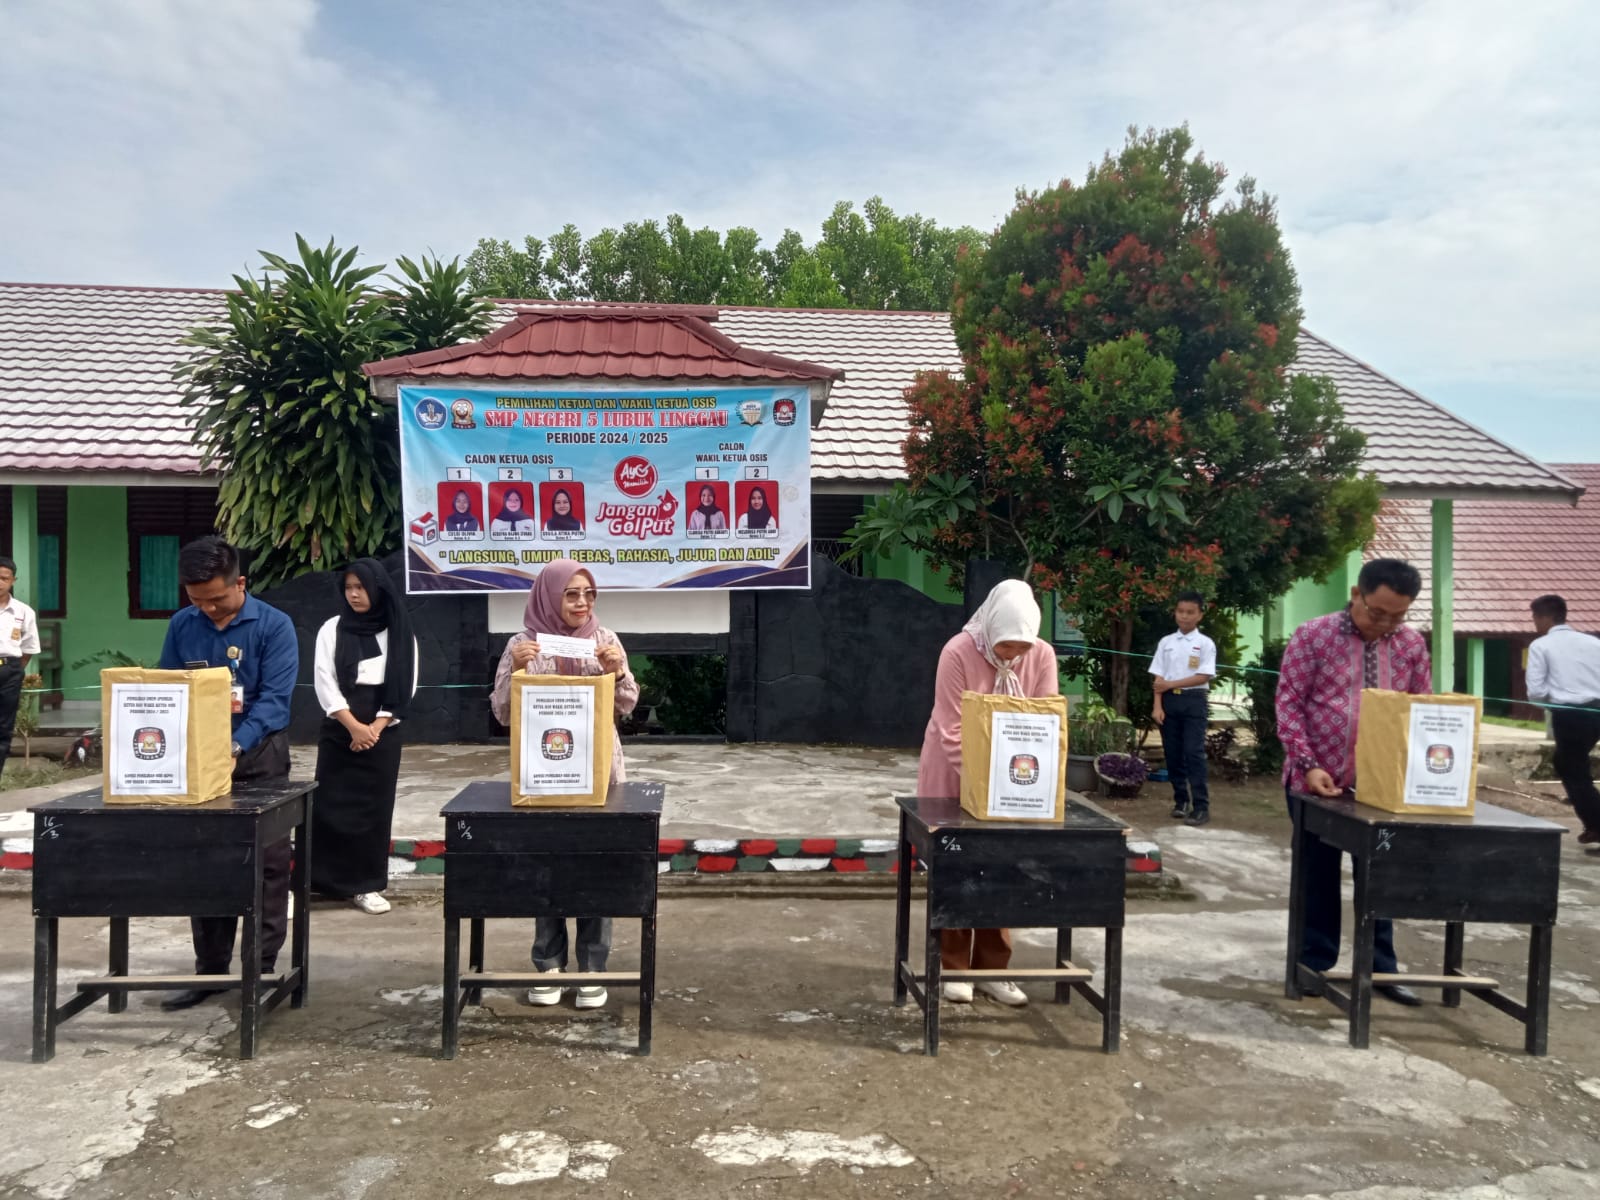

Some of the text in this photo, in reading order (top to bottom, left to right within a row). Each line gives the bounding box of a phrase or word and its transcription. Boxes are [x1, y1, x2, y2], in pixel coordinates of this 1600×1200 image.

[496, 397, 716, 409] PEMILIHAN KETUA DAN WAKIL KETUA OSIS
[485, 410, 729, 428] SMP NEGERI 5 LUBUK LINGGAU
[546, 432, 596, 444] PERIODE
[600, 432, 629, 444] 2024
[639, 432, 668, 444] 2025
[719, 443, 745, 451] CALON
[465, 454, 554, 464] CALON KETUA OSIS
[696, 453, 768, 462] WAKIL KETUA OSIS
[456, 470, 462, 478] 1
[507, 470, 513, 479] 2
[558, 470, 564, 479] 3
[705, 469, 710, 478] 1
[753, 469, 760, 478] 2
[596, 502, 658, 521] Jangan
[449, 549, 520, 565] LANGSUNG,
[521, 549, 565, 563] UMUM
[569, 549, 614, 565] BEBAS,
[616, 549, 674, 564] RAHASIA,
[676, 548, 717, 562] JUJUR
[719, 547, 744, 561] DAN
